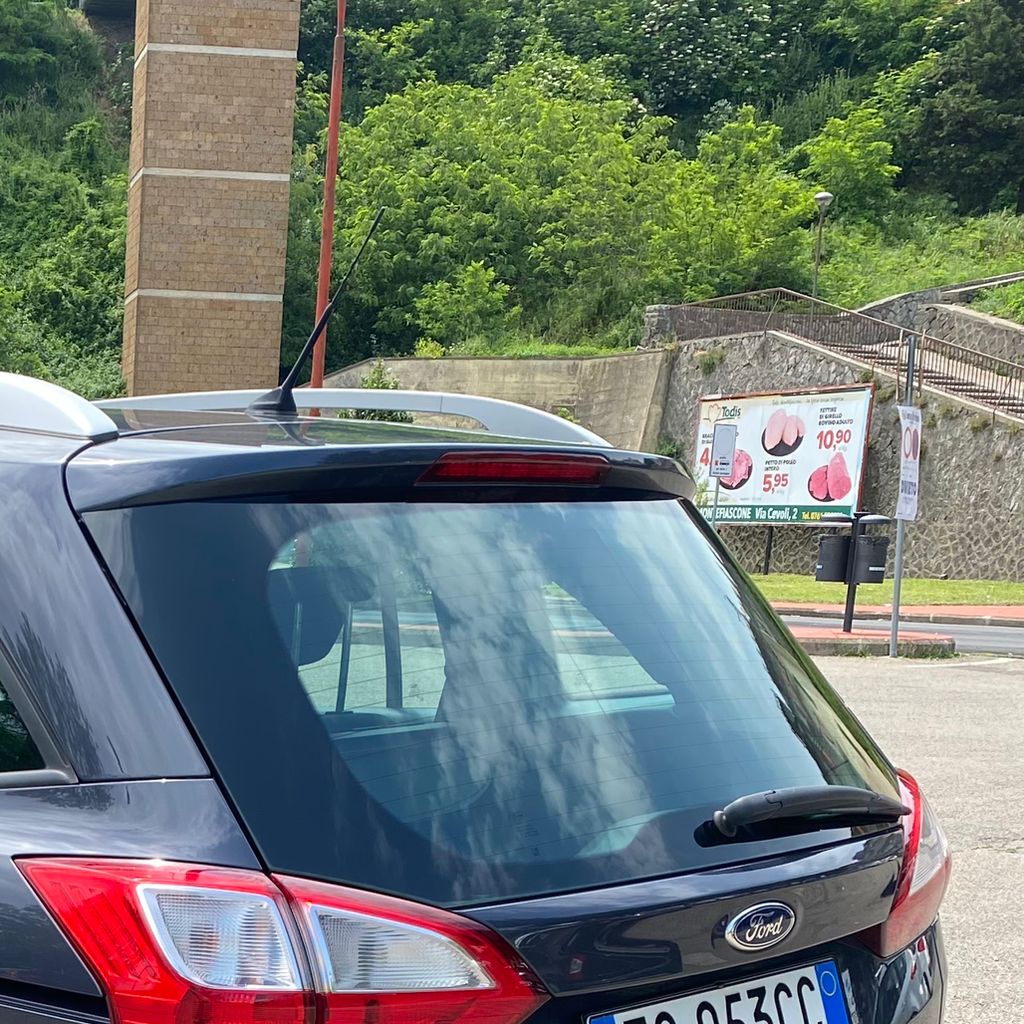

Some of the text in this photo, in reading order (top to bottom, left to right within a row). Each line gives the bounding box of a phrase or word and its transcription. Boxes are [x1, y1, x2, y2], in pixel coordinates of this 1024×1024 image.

[722, 405, 741, 417] Todis
[817, 429, 852, 451] 10,90
[762, 473, 789, 494] 5,95
[755, 507, 767, 519] Via
[767, 507, 791, 521] Cevoli,
[792, 507, 798, 519] 2
[745, 911, 783, 941] Ford
